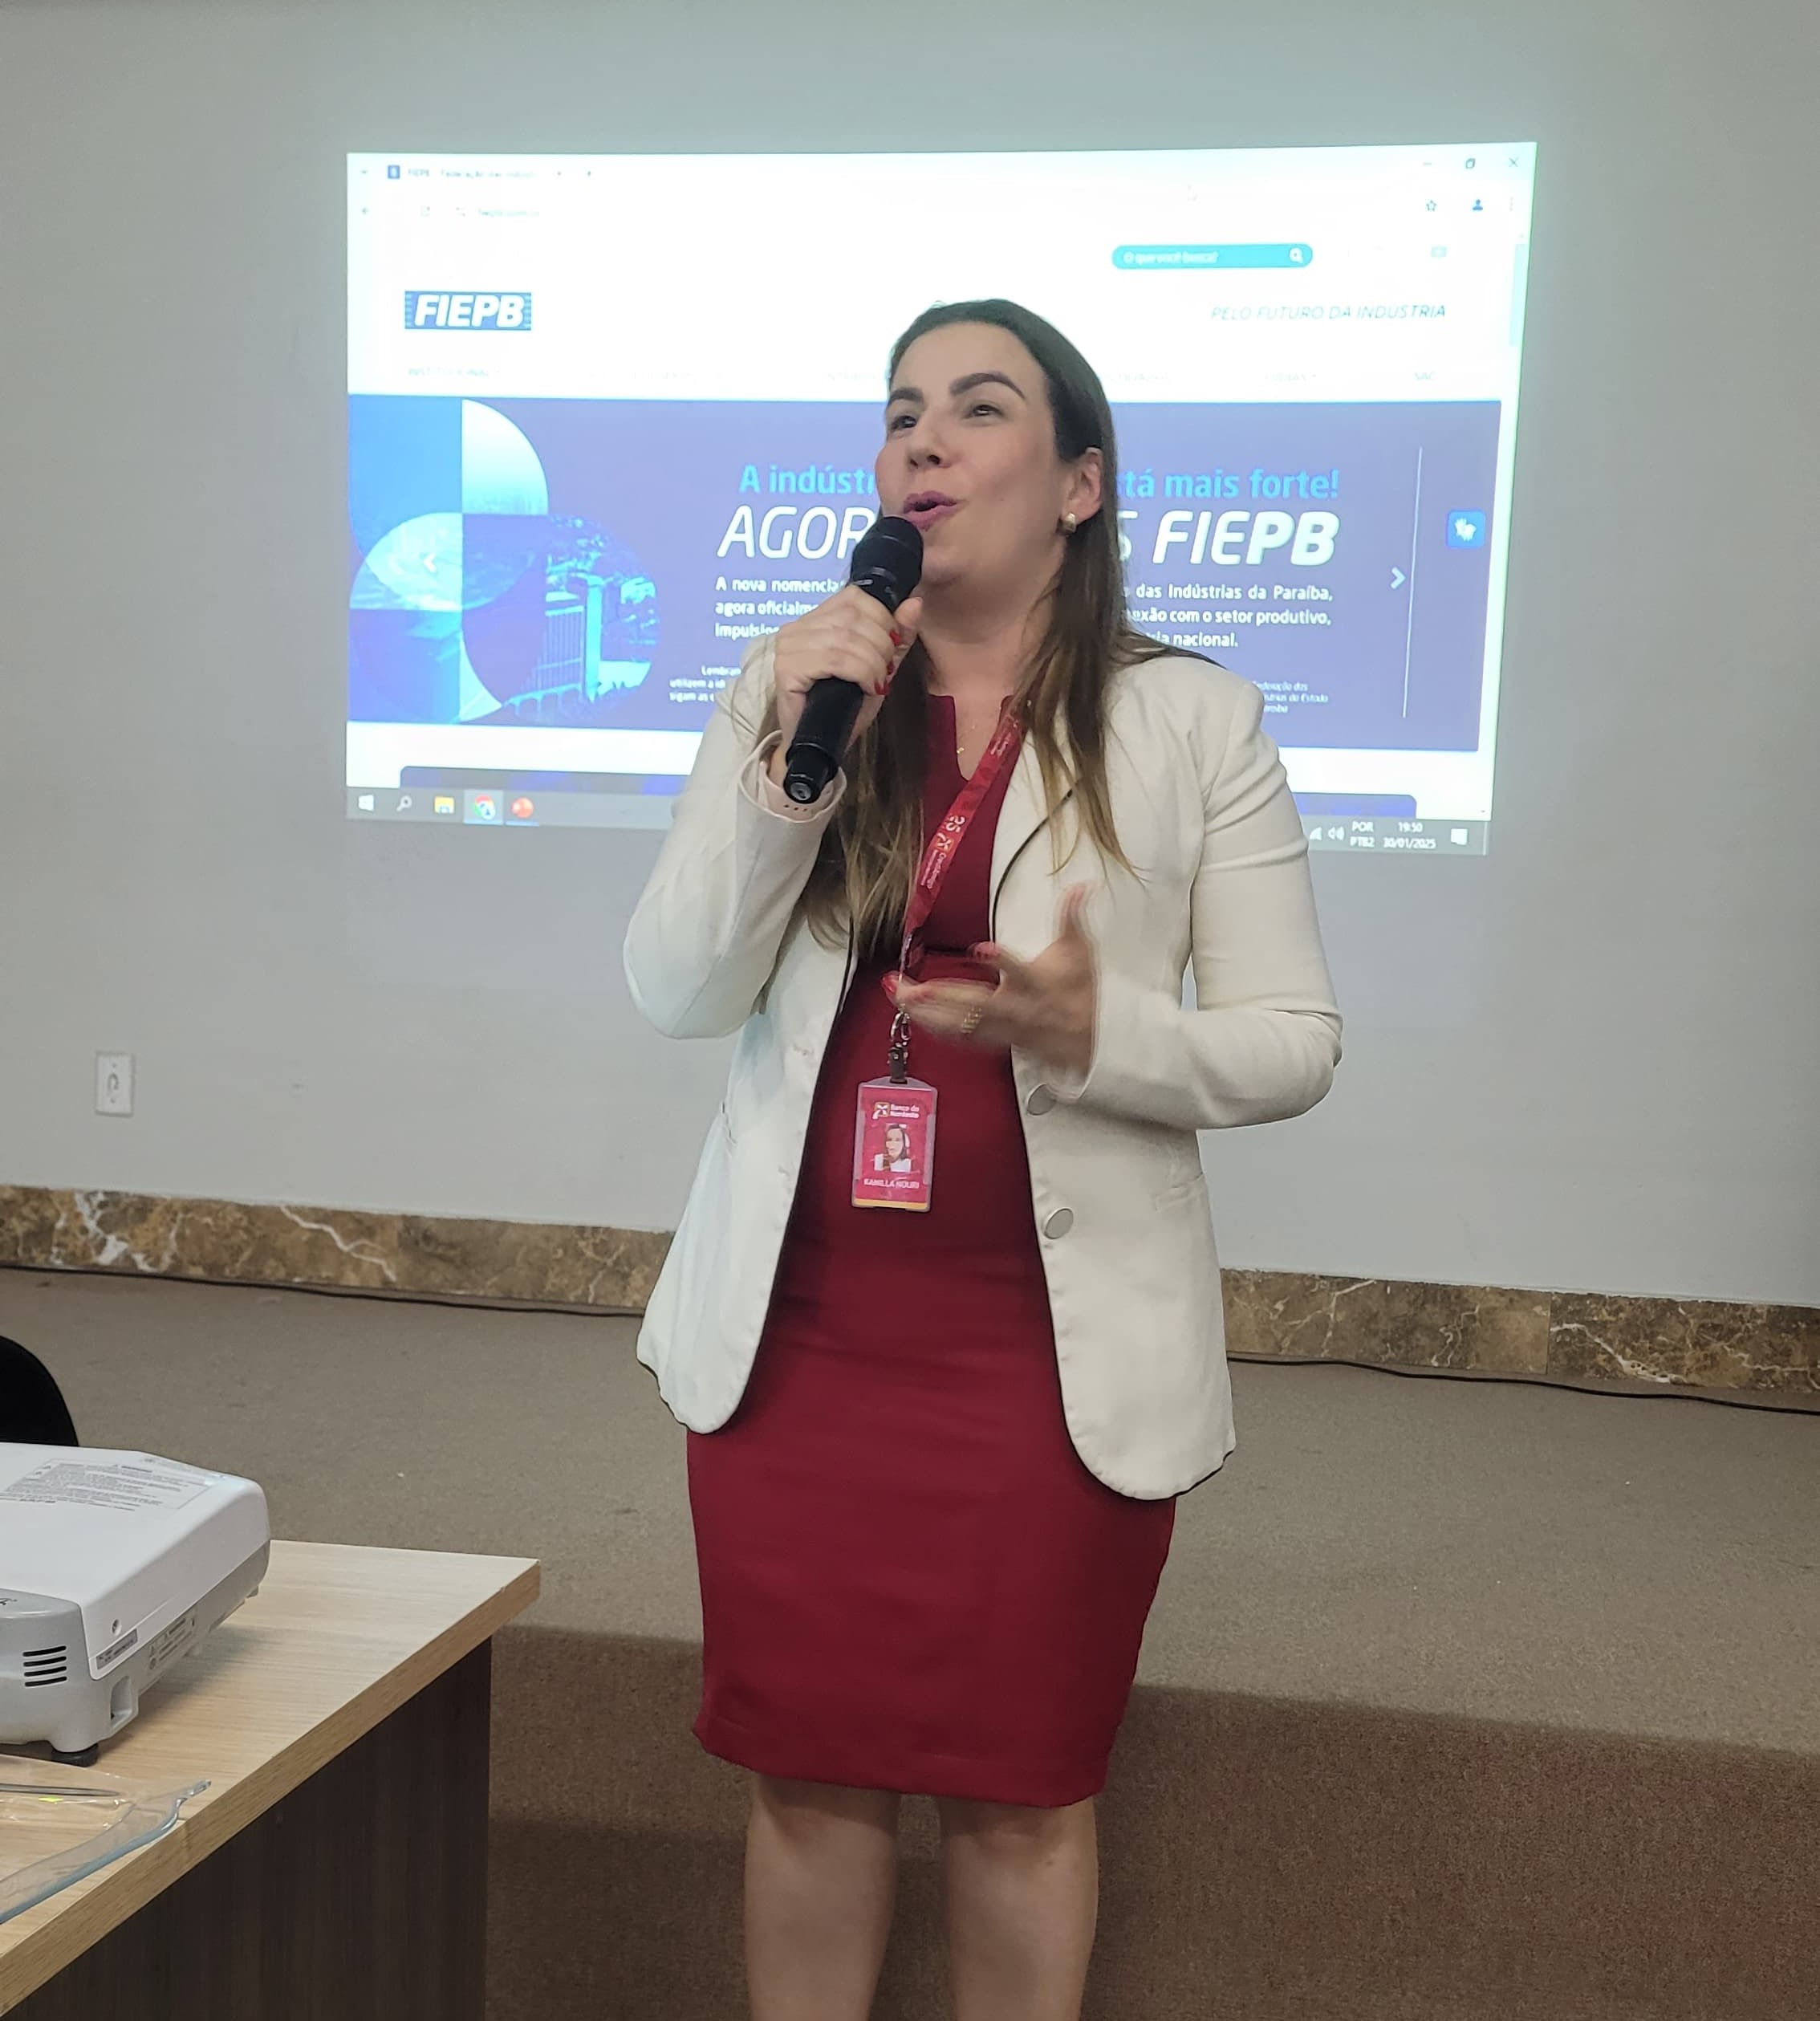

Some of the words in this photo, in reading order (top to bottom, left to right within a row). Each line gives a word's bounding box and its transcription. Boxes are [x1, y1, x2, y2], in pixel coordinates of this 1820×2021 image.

[413, 294, 526, 328] FIEPB
[1211, 306, 1252, 320] PELO
[1257, 306, 1324, 319] FUTURO
[1329, 306, 1351, 319] DA
[738, 464, 761, 494] A
[769, 464, 875, 495] indústr
[1117, 470, 1155, 499] tá
[1164, 470, 1240, 499] mais
[1249, 470, 1339, 499] forte!
[717, 504, 875, 559] AGOR
[1152, 509, 1341, 565] FIEPB
[715, 575, 727, 592] A
[732, 579, 766, 592] nova
[771, 577, 844, 593] nomencla
[1135, 583, 1163, 599] das
[1168, 583, 1242, 600] Indústrias
[1248, 584, 1267, 600] da
[1274, 584, 1333, 602] Paraíba,
[715, 602, 755, 617] agora
[758, 600, 819, 616] oficialm
[1127, 607, 1167, 624] exão
[1169, 610, 1200, 623] com
[1202, 611, 1213, 624] o
[1215, 609, 1253, 624] setor
[1256, 608, 1331, 626] produtivo,
[1172, 631, 1238, 648] nacional.
[1351, 821, 1375, 832] POR
[1398, 822, 1424, 833] 19:50
[1383, 837, 1436, 849] 30/01/2025
